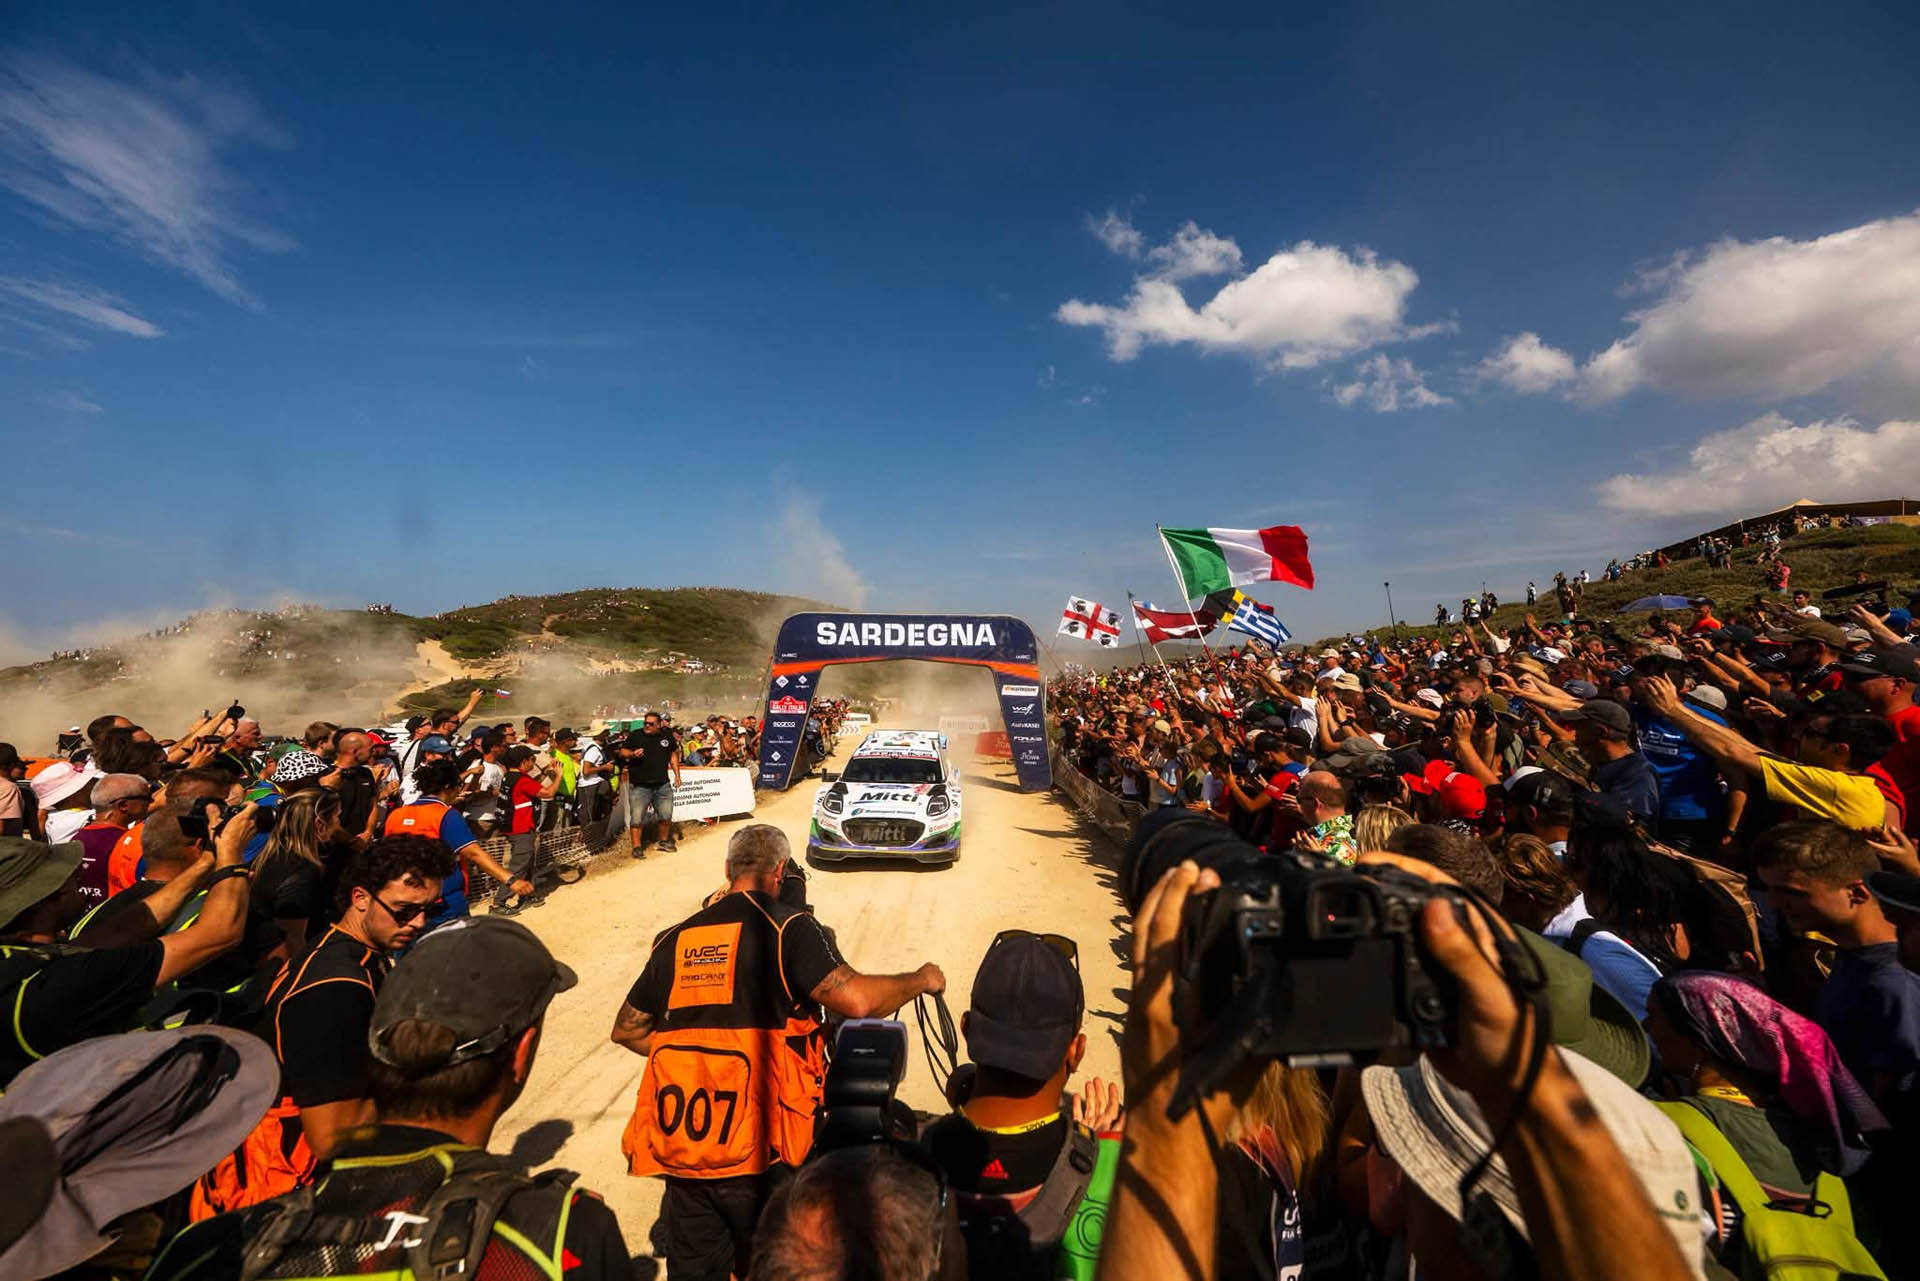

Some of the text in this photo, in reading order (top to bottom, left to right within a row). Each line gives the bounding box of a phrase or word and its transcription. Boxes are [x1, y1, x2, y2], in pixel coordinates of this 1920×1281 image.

[816, 622, 997, 646] SARDEGNA
[860, 792, 919, 802] Mitti
[862, 826, 906, 841] Mitti
[684, 943, 730, 959] WRC
[657, 1084, 738, 1145] 007
